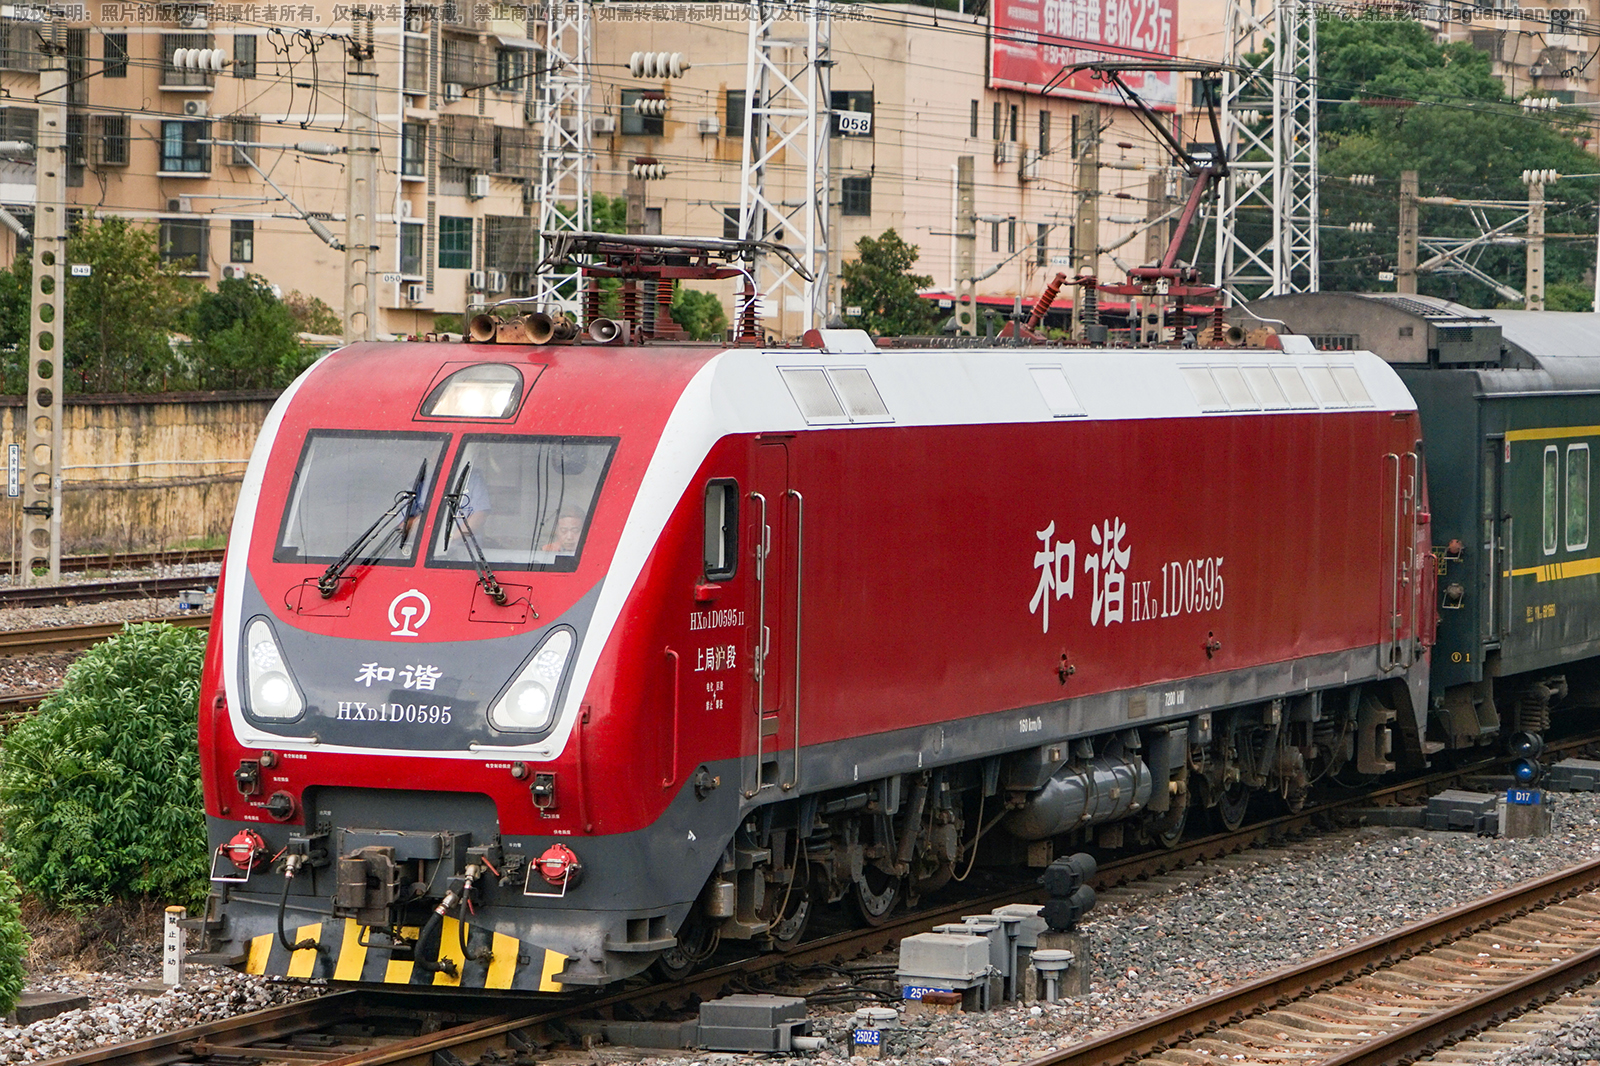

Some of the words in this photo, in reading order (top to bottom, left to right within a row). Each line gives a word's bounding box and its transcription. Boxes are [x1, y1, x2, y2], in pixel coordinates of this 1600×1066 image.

[842, 117, 868, 131] 058
[384, 274, 401, 282] 050
[1028, 515, 1132, 635] 和谐
[694, 644, 737, 672] 上局沪段
[354, 662, 444, 691] 和谐
[336, 701, 453, 725] HXD1D0595
[1516, 791, 1531, 802] D17
[168, 917, 176, 966] 禁止移动
[856, 1030, 879, 1044] 25DZ-E
